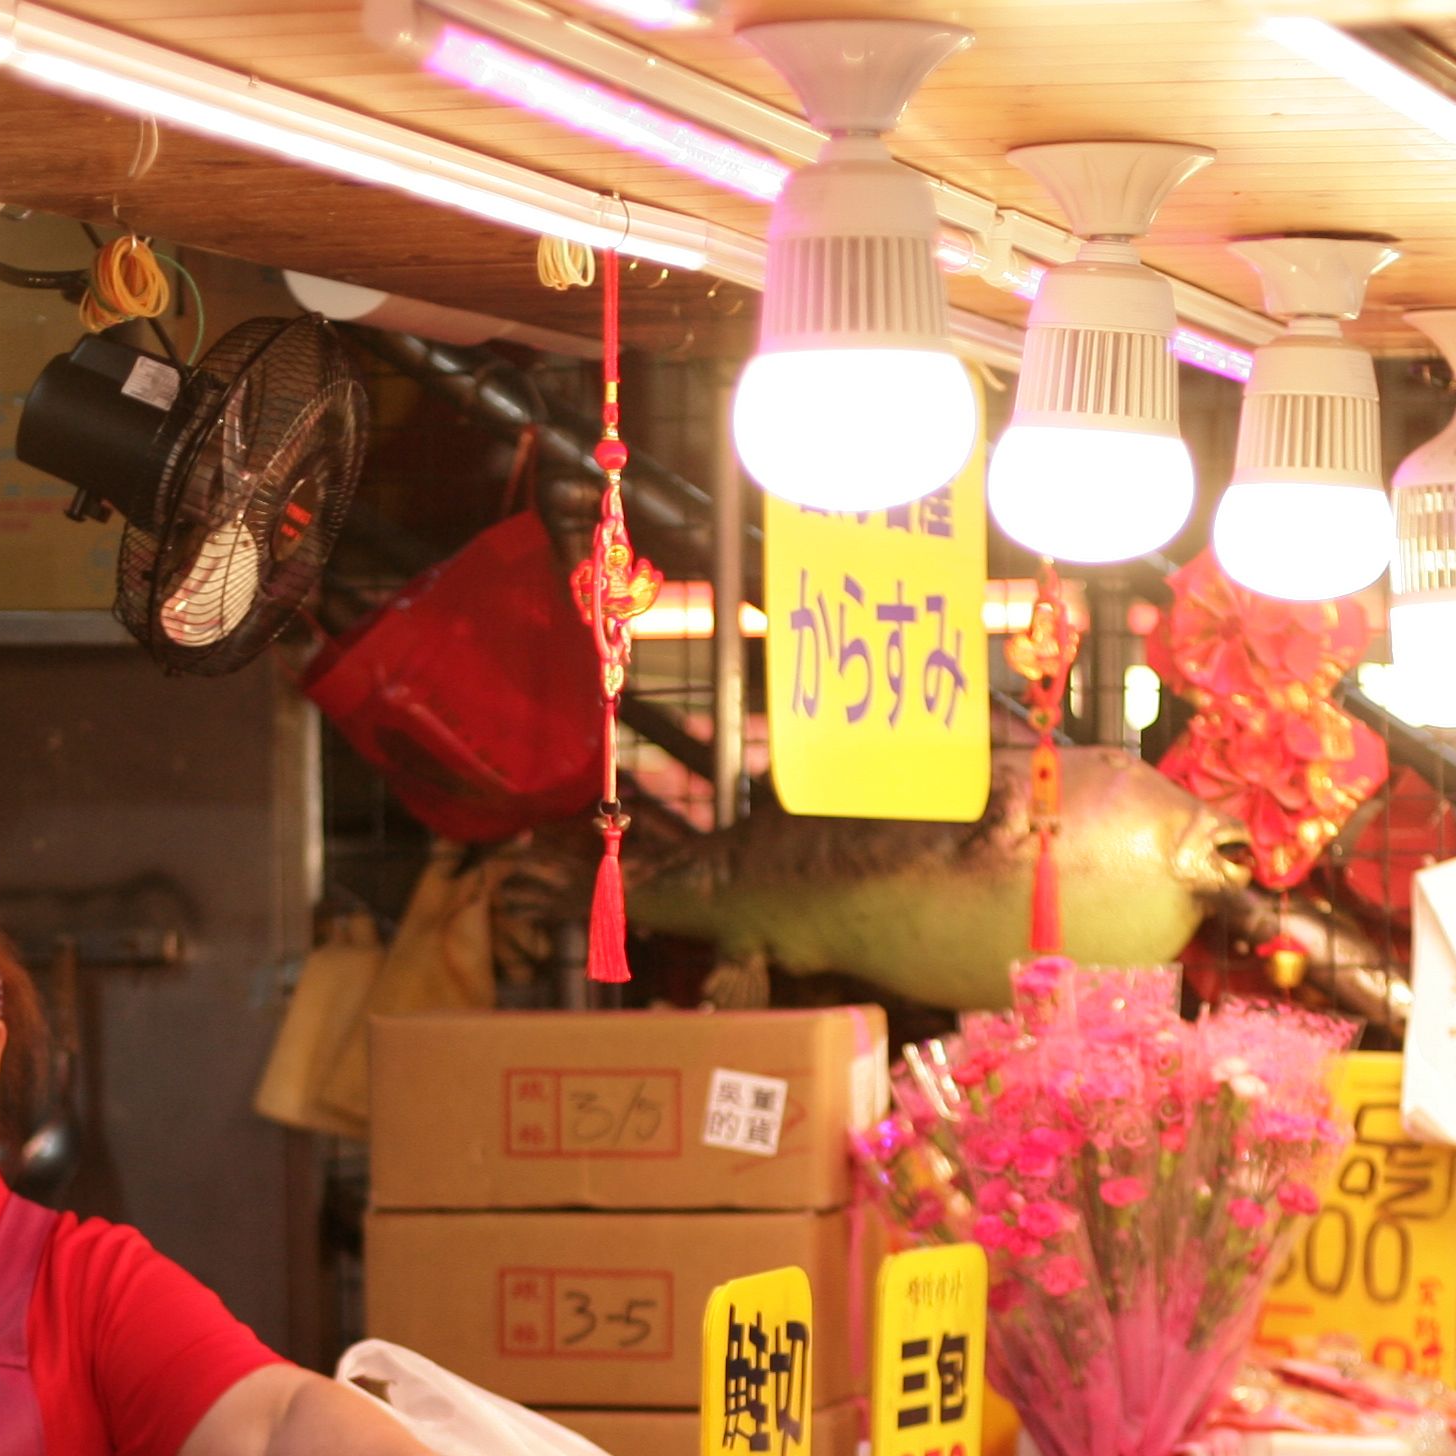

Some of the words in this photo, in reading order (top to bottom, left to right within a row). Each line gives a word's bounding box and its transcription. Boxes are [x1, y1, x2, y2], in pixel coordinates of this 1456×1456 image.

[790, 568, 967, 735] からすみ
[563, 1290, 656, 1349] 3-5
[897, 1333, 969, 1431] 三包
